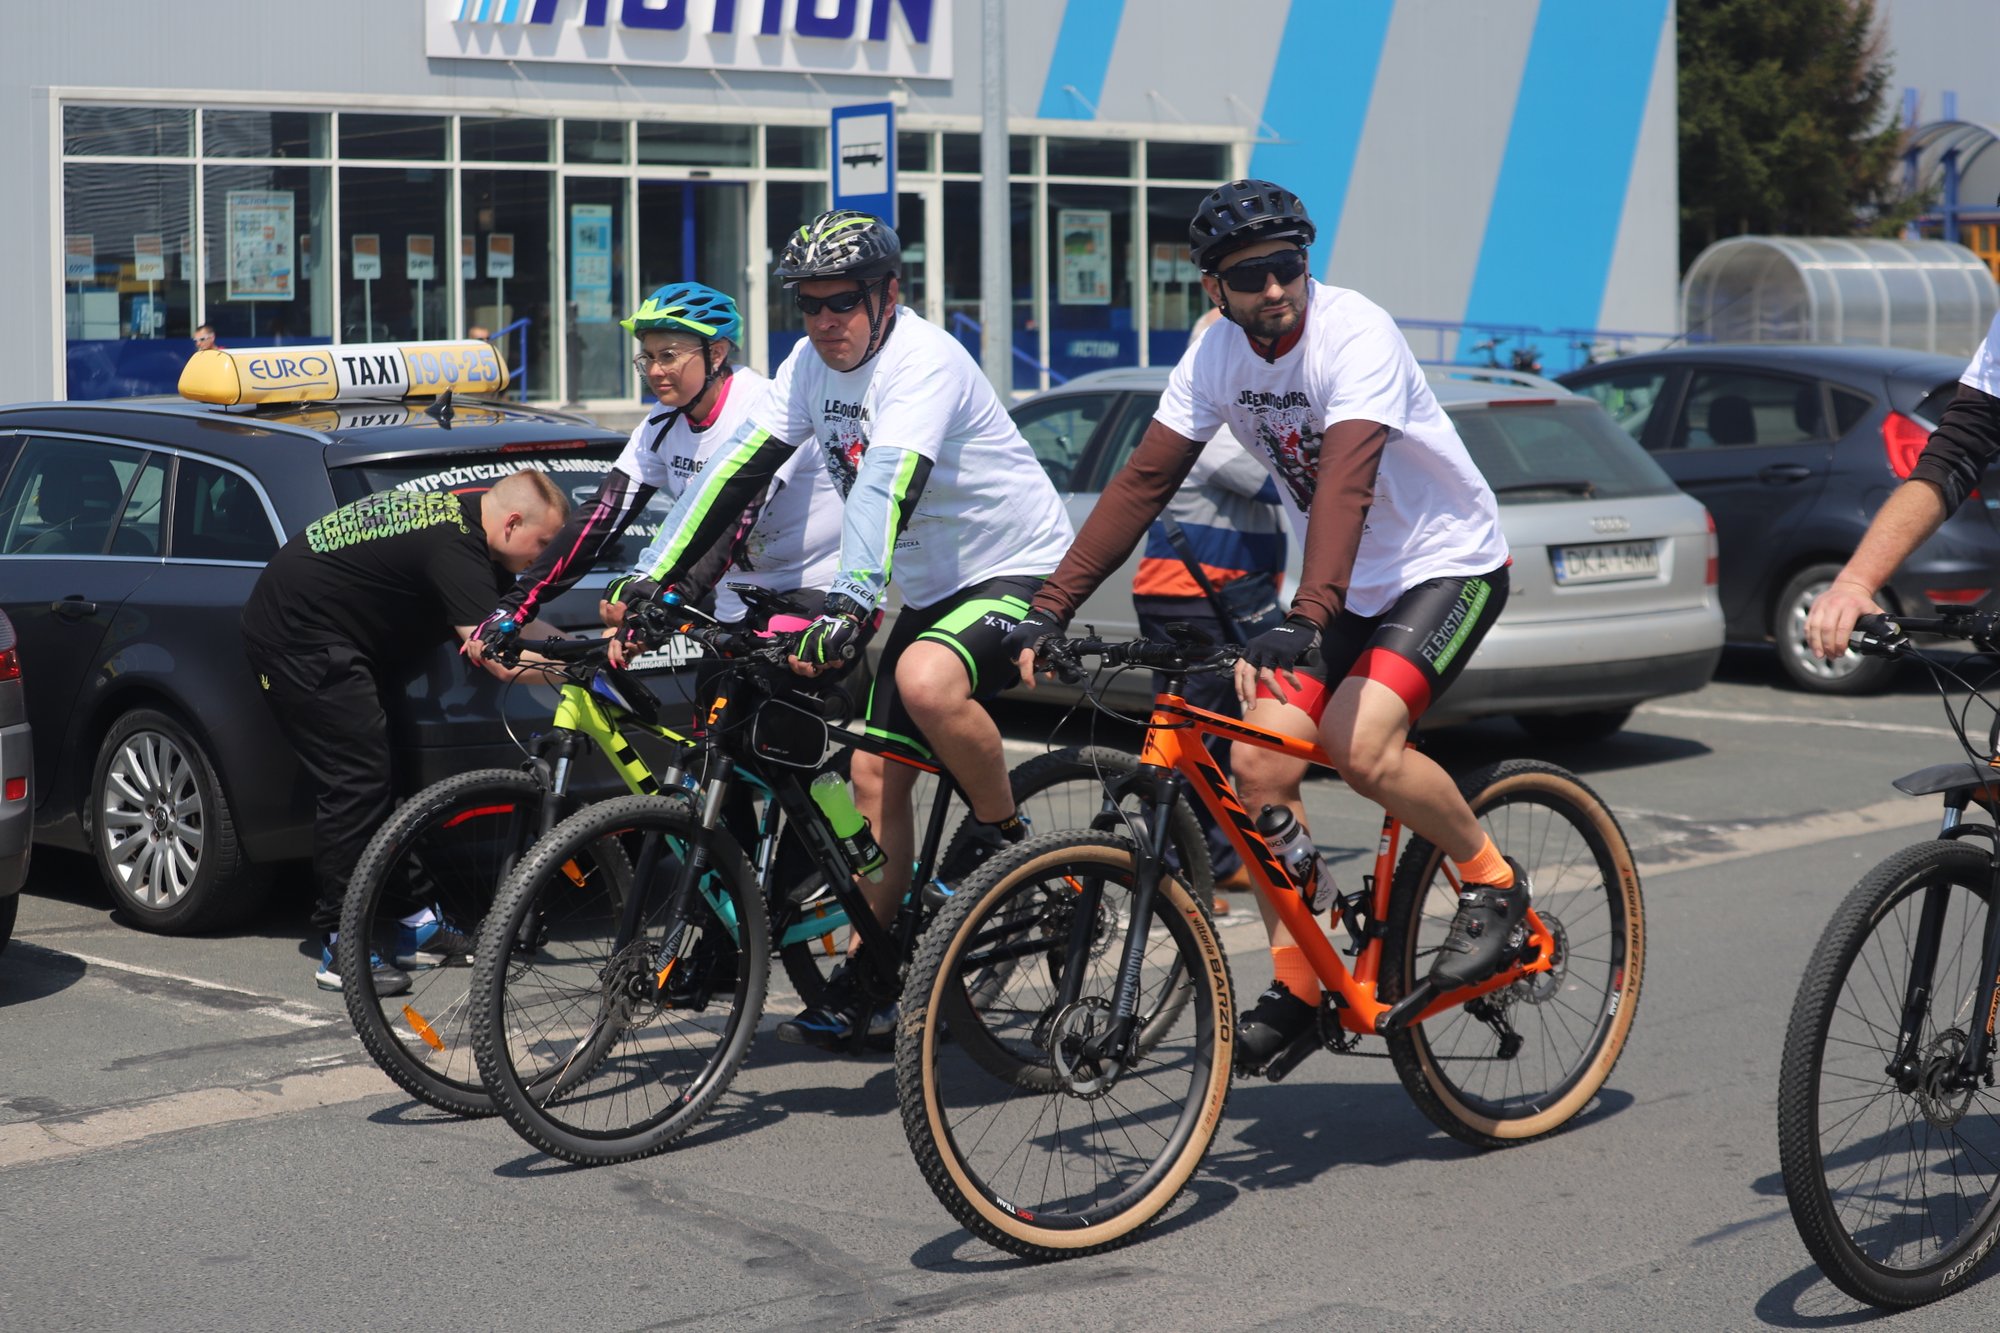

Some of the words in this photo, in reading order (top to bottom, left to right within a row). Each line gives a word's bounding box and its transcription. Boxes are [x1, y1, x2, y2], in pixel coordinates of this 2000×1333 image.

[249, 356, 328, 380] EURO
[342, 355, 400, 386] TAXI
[408, 350, 498, 385] 196-25
[1070, 340, 1119, 358] ACTION
[1421, 600, 1470, 664] FLEXISTAV
[1626, 922, 1640, 997] MEZCAL
[1209, 958, 1230, 1043] BARZO
[996, 1195, 1017, 1215] TEAM
